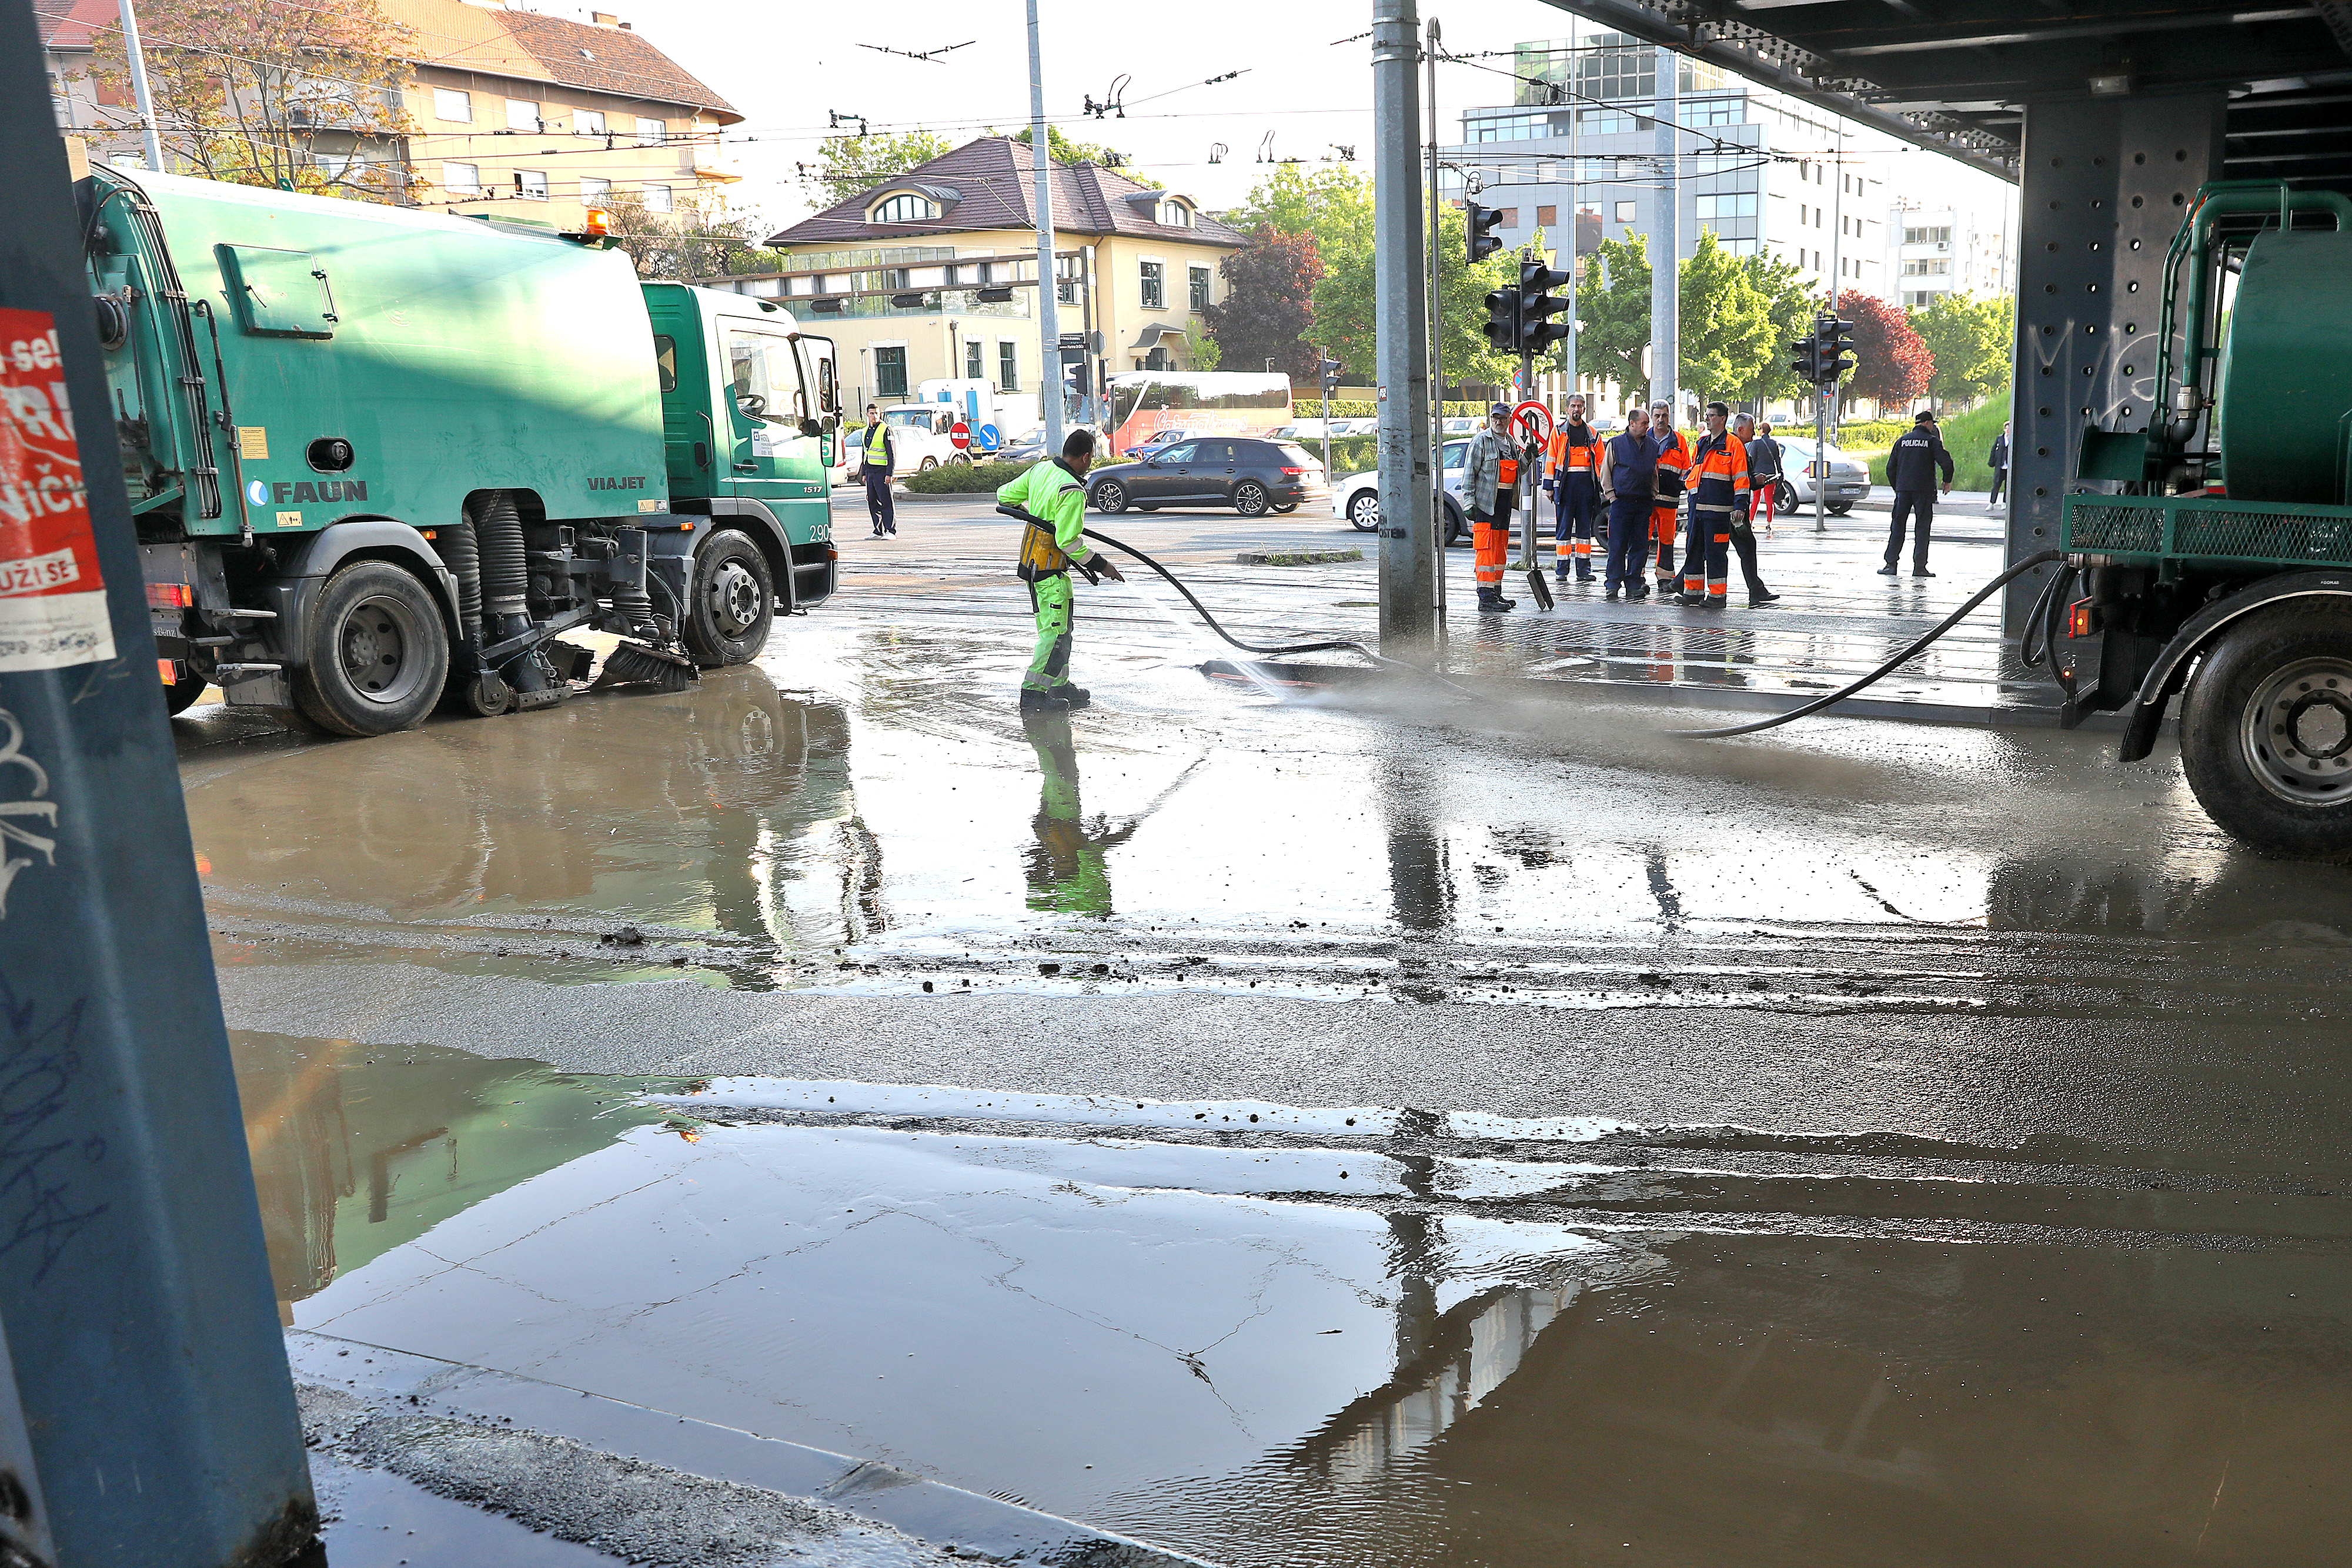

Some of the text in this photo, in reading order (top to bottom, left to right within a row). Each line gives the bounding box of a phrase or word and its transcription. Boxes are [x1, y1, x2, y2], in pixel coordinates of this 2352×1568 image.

[1901, 439, 1929, 447] POLICIJA
[272, 480, 368, 504] FAUN
[587, 476, 646, 490] VIAJET
[809, 523, 830, 542] 290
[46, 560, 70, 581] SE
